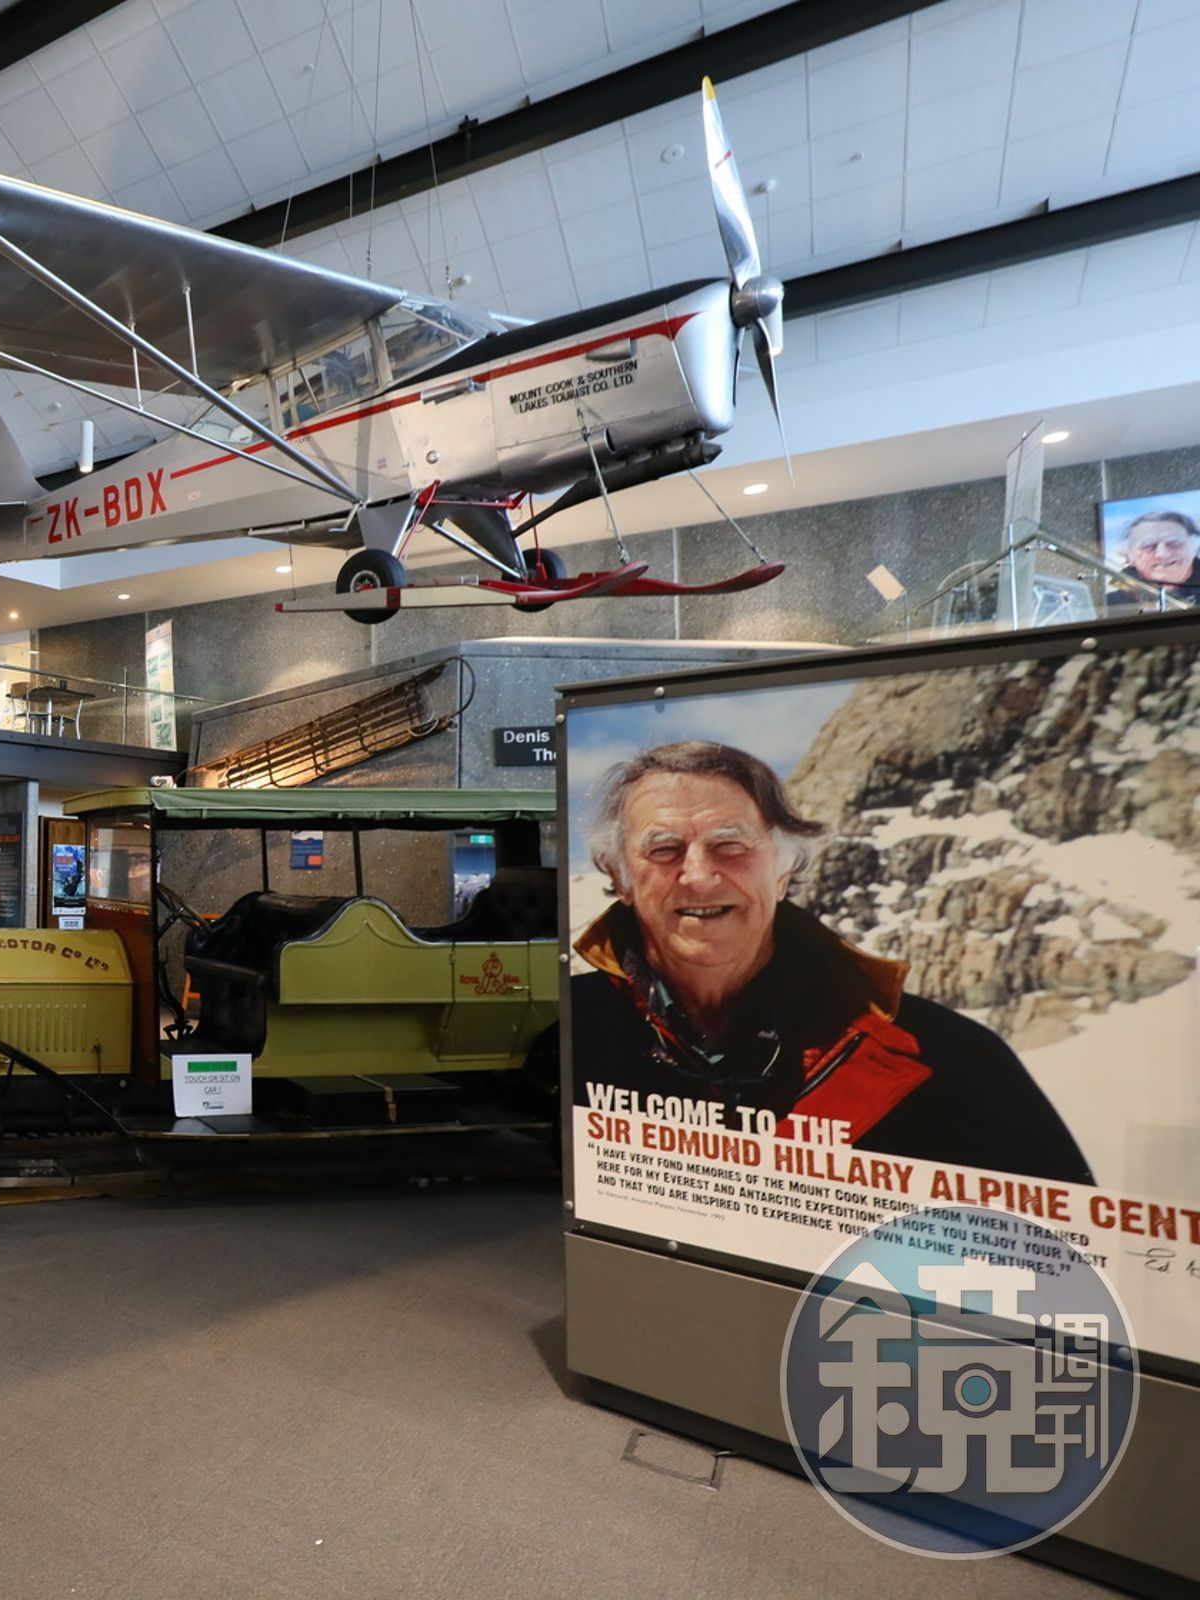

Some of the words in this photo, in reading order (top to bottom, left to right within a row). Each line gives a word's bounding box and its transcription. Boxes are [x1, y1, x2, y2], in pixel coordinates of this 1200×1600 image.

[509, 387, 542, 405] MOUNT
[545, 378, 574, 395] COOK
[576, 375, 585, 386] &
[587, 360, 638, 383] SOUTHERN
[519, 398, 548, 414] LAKES
[552, 386, 590, 405] TOURIST
[47, 467, 167, 544] ZK-BDX
[503, 729, 550, 744] Denis
[532, 748, 557, 762] Th
[586, 1081, 726, 1130] WELCOME
[736, 1105, 777, 1138] TO
[787, 1113, 852, 1149] THE
[587, 1112, 631, 1145] SIR
[642, 1122, 761, 1167] EDMUND
[774, 1144, 913, 1194] HILLARY
[930, 1169, 1071, 1222] ALPINE
[603, 1148, 626, 1161] HAVE
[630, 1152, 653, 1165] VERY
[657, 1158, 683, 1171] FOND
[687, 1163, 742, 1182] MEMORIES
[746, 1173, 759, 1185] OF
[764, 1177, 785, 1190] THE
[789, 1181, 831, 1198] MOUNT
[835, 1189, 868, 1208] COOK
[873, 1197, 919, 1215] REGION
[924, 1206, 961, 1223] FROM
[966, 1213, 1008, 1232] WHEN
[1024, 1223, 1089, 1247] TRAINED
[597, 1161, 621, 1173] HERE
[624, 1165, 642, 1177] FOR
[645, 1170, 660, 1181] MY
[663, 1172, 709, 1190] EVEREST
[714, 1183, 735, 1195] AND
[739, 1187, 801, 1208] ANTARCTIC
[902, 1218, 937, 1236] HOPE
[941, 1226, 967, 1241] YOU
[972, 1232, 1017, 1250] ENJOY
[1022, 1242, 1061, 1260] YOUR
[597, 1174, 616, 1186] AND
[620, 1179, 643, 1192] THAT
[646, 1183, 665, 1197] YOU
[668, 1189, 689, 1201] ARE
[692, 1193, 740, 1212] INSPIRED
[744, 1203, 758, 1215] TO
[762, 1207, 833, 1231] EXPERIENCE
[837, 1221, 869, 1238] YOUR
[874, 1229, 903, 1244] OWN
[908, 1236, 955, 1256] ALPINE
